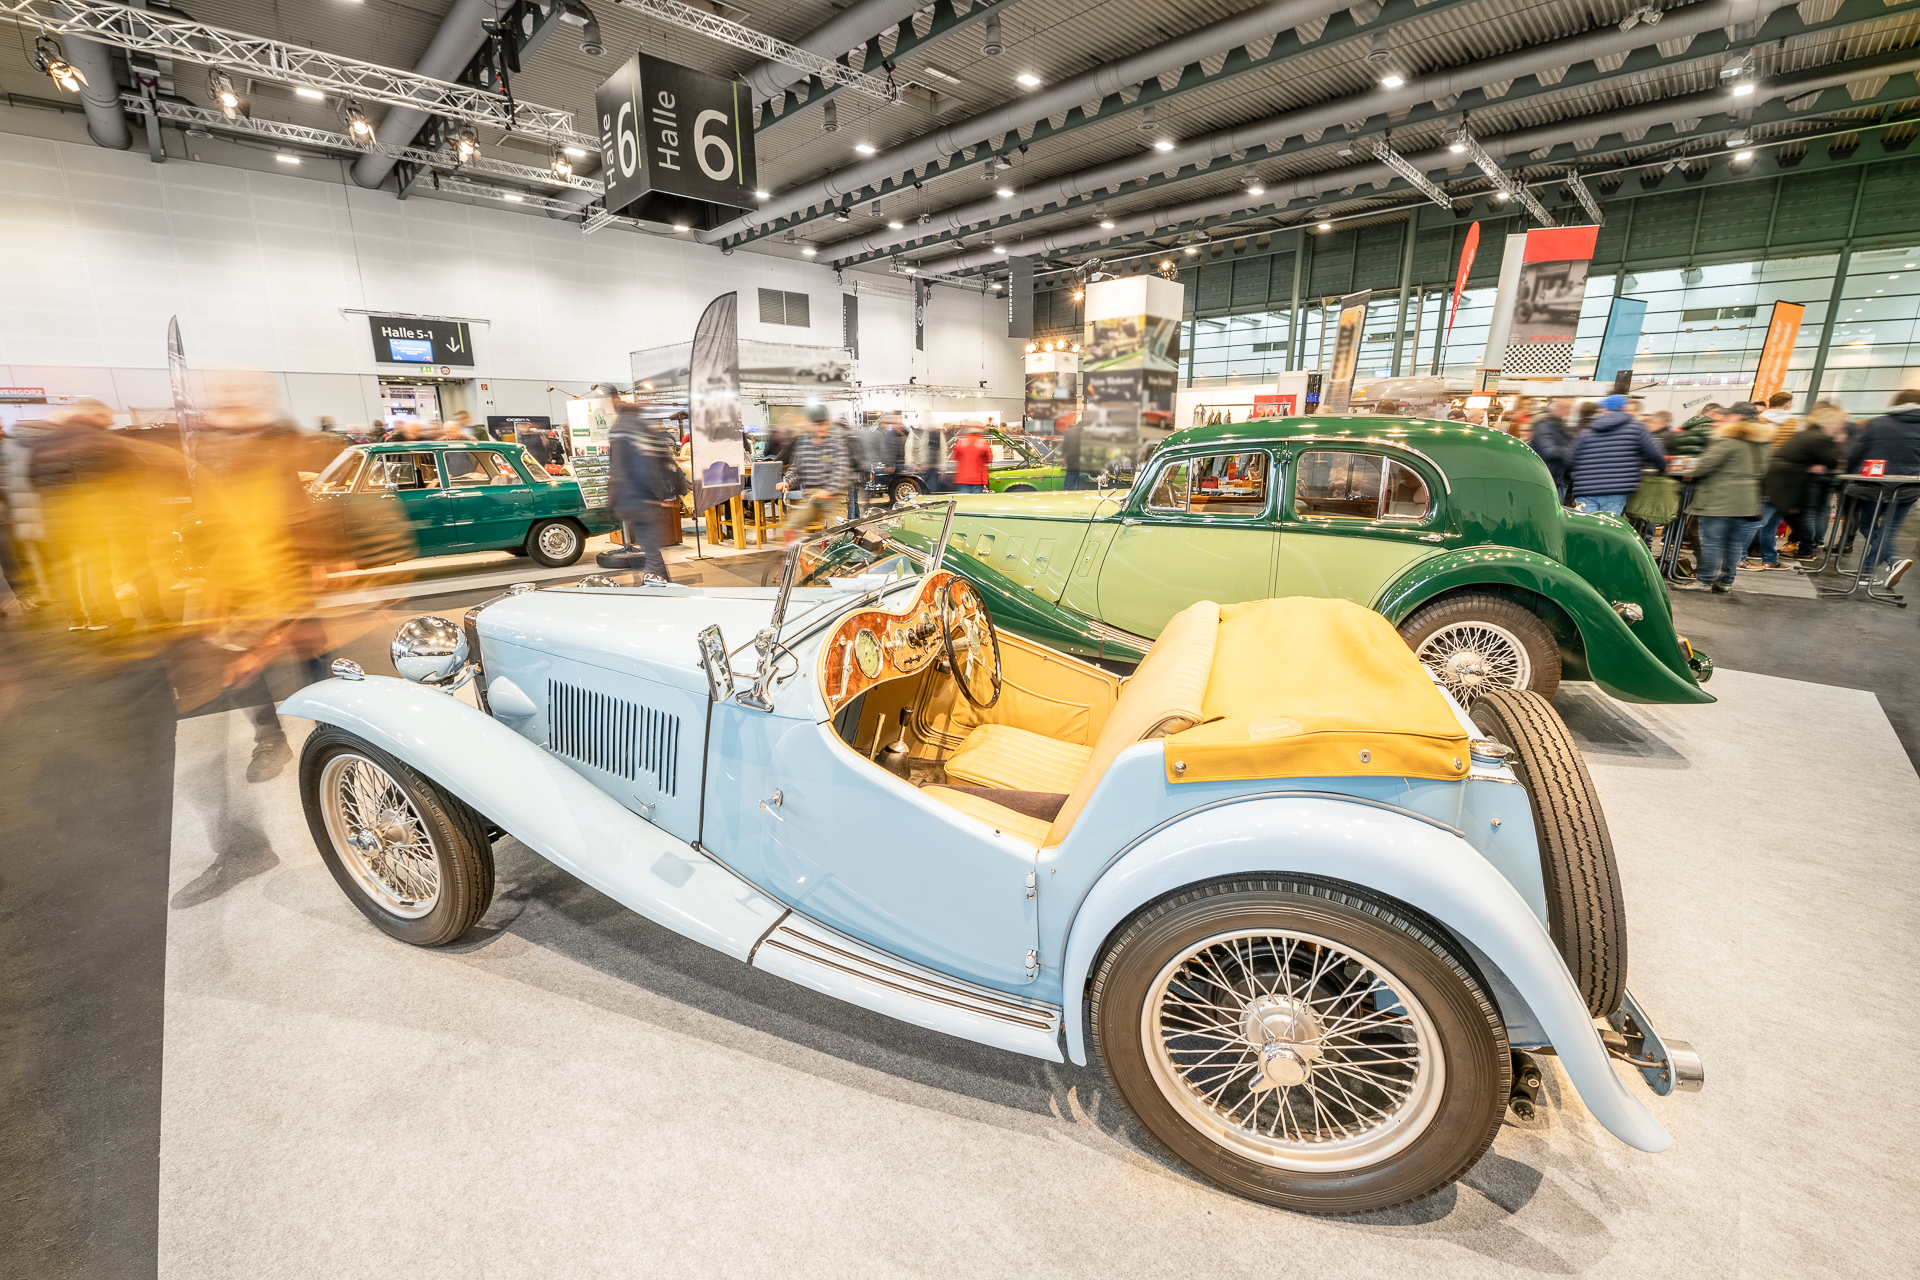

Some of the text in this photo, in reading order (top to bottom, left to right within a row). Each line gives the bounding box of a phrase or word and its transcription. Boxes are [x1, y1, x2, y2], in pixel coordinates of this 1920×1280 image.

[602, 113, 617, 190] Halle
[617, 101, 637, 178] 6
[652, 90, 681, 171] Halle
[693, 109, 734, 181] 6
[381, 326, 434, 340] Halle 5-1
